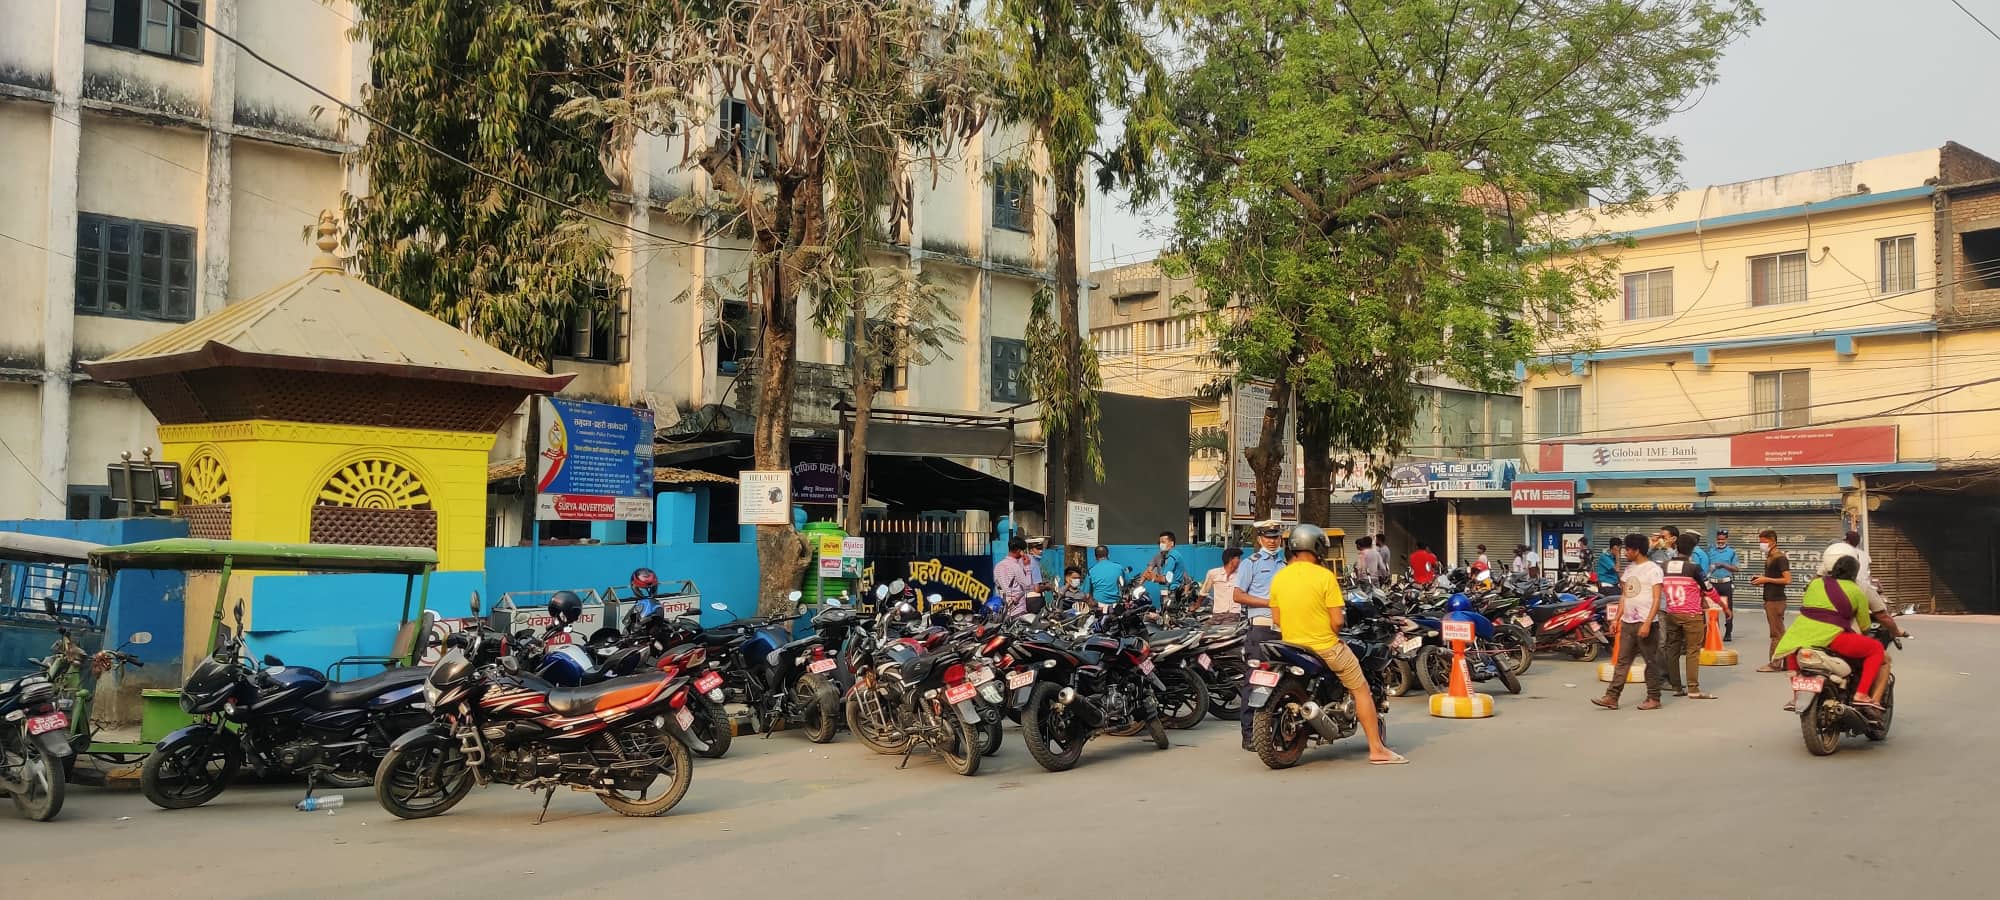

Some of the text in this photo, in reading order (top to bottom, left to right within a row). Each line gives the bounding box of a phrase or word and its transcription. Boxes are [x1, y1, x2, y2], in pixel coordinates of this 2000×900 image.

[1612, 446, 1697, 457] Global IME Bank
[1430, 463, 1446, 473] THE
[1471, 462, 1494, 472] LOOK
[1514, 489, 1541, 501] ATM
[558, 503, 577, 511] SURYA
[579, 503, 615, 512] ADVERTISING
[908, 559, 942, 585] प्रहरी
[941, 566, 991, 605] कार्यालय
[1666, 585, 1686, 607] 19
